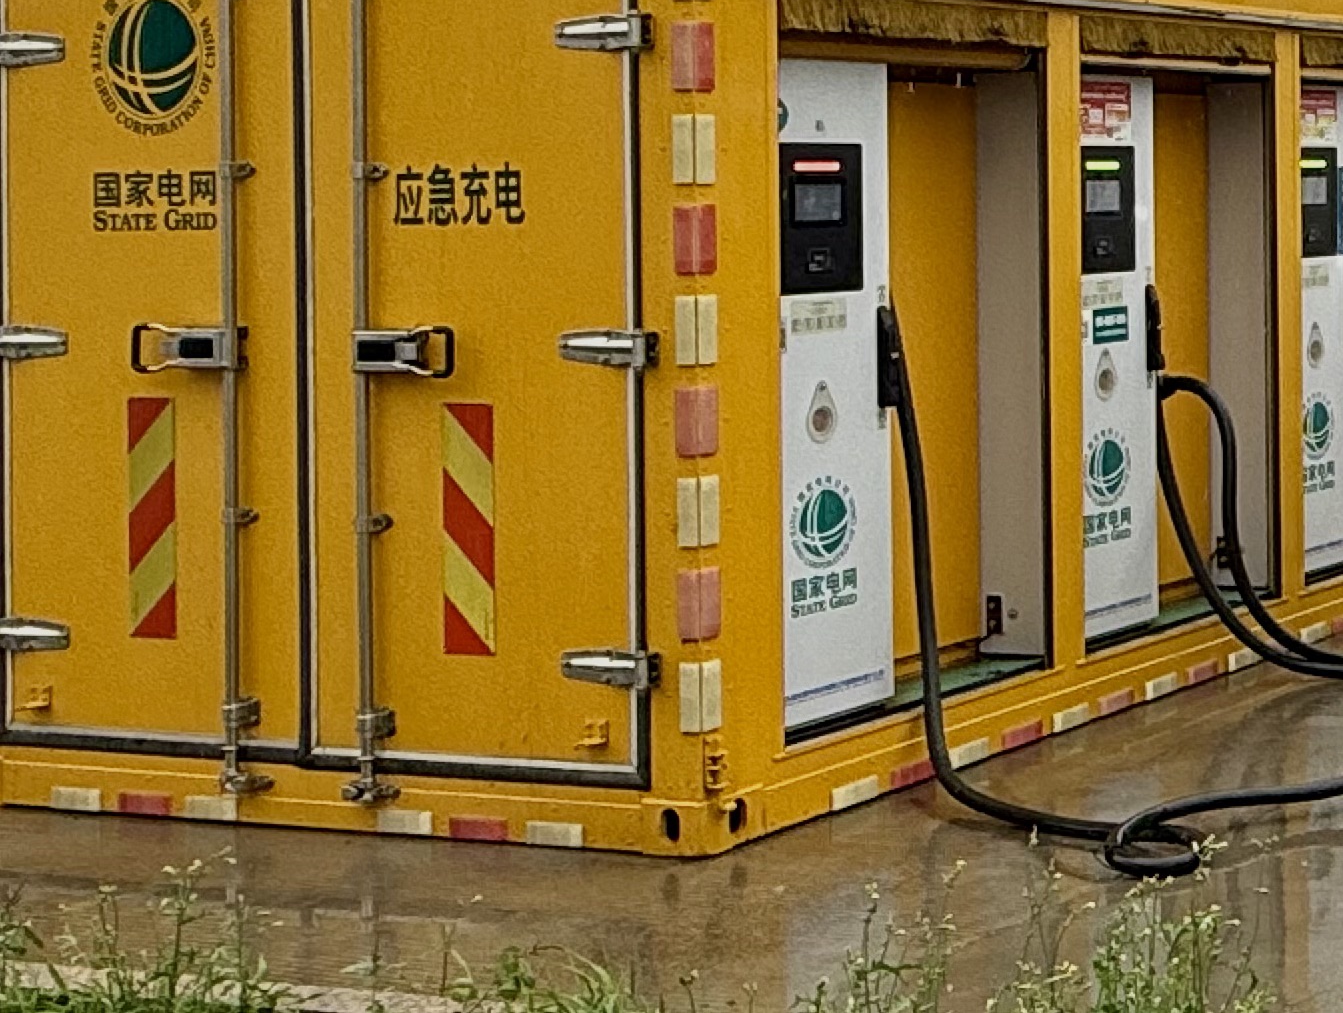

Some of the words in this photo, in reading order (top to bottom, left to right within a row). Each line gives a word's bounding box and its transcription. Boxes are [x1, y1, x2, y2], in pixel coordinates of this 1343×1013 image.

[115, 97, 204, 136] CORPORATION
[93, 168, 217, 208] 国家电网
[393, 161, 526, 226] 应急充电
[93, 209, 157, 232] STATE
[164, 208, 218, 231] GRID
[790, 567, 858, 603] 国家电网
